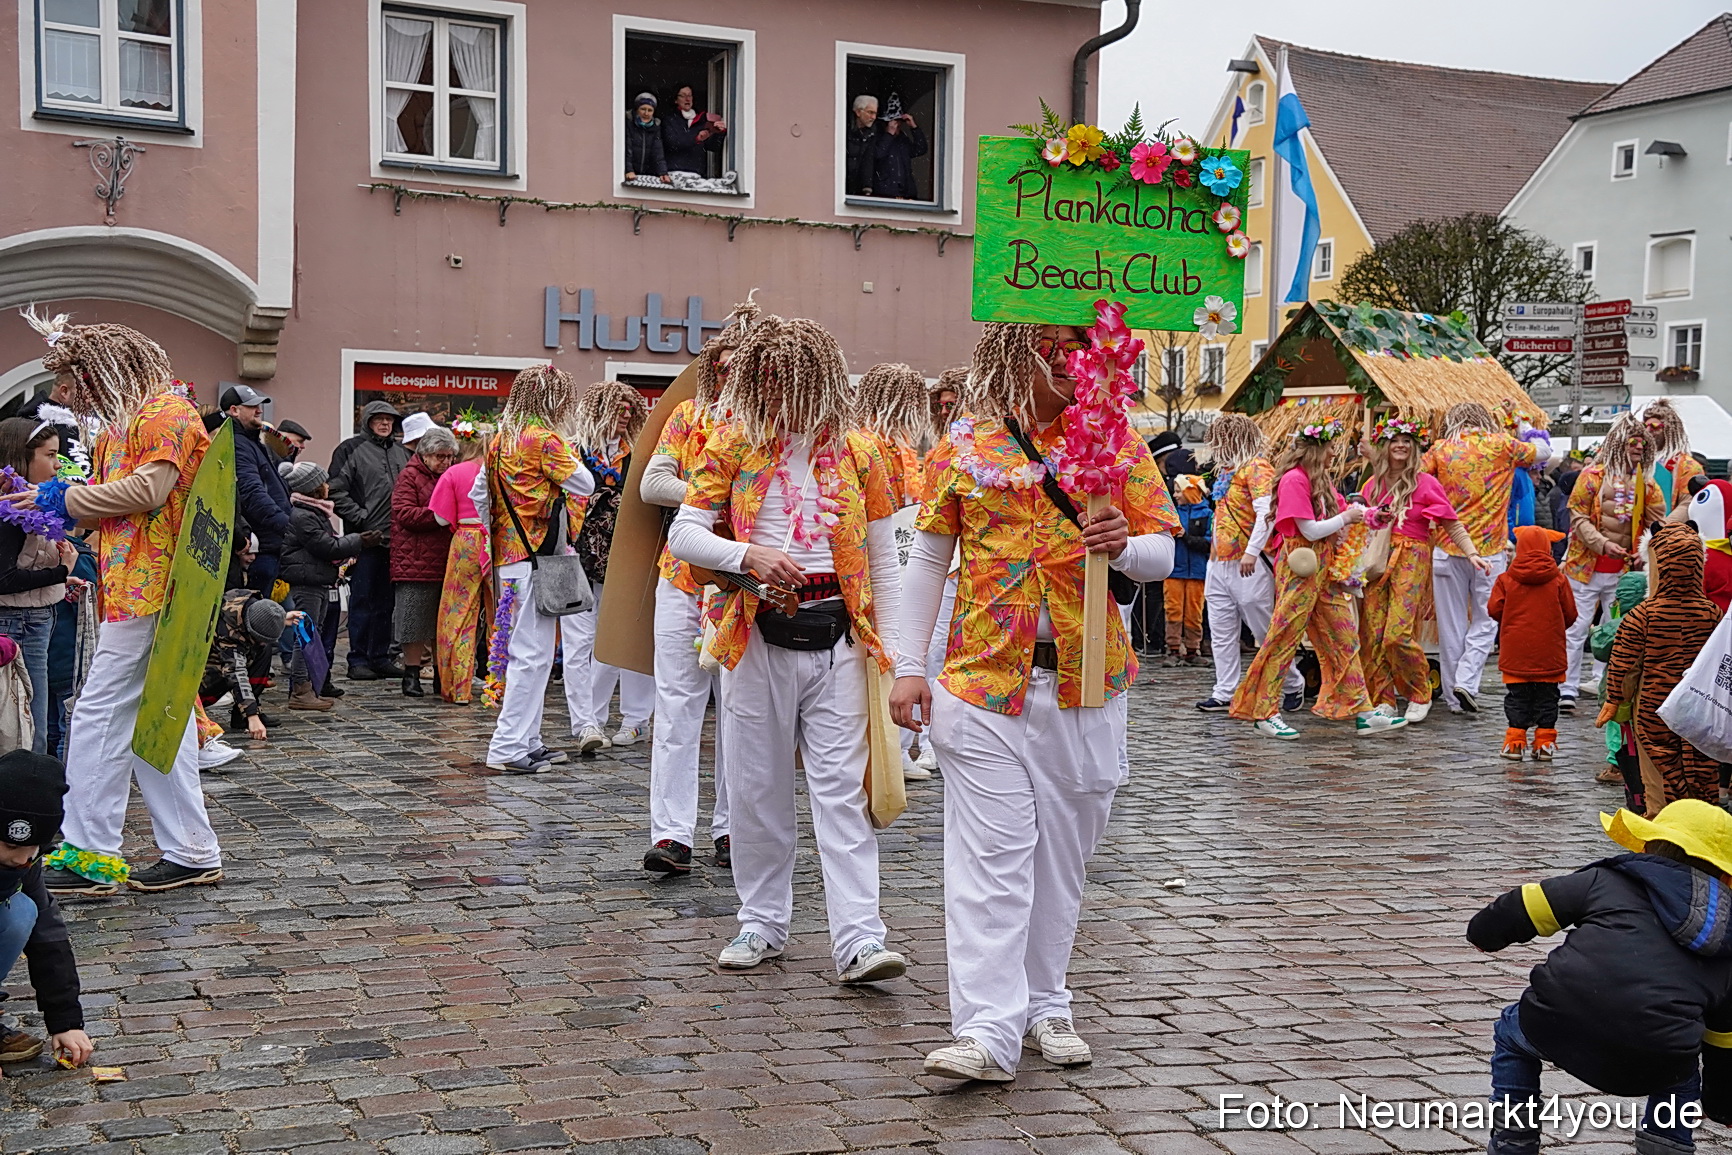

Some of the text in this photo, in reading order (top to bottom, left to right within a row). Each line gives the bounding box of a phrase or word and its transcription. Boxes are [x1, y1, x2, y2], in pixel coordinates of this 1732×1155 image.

[1007, 169, 1210, 235] Plankaloha
[1004, 239, 1202, 296] Beach Club
[544, 286, 738, 354] Hutt
[1532, 306, 1573, 316] Europahalle
[1514, 323, 1560, 332] Eine-Welt-Laden
[1512, 341, 1556, 350] Bücherei
[382, 372, 499, 391] idee+spiel HUTTER
